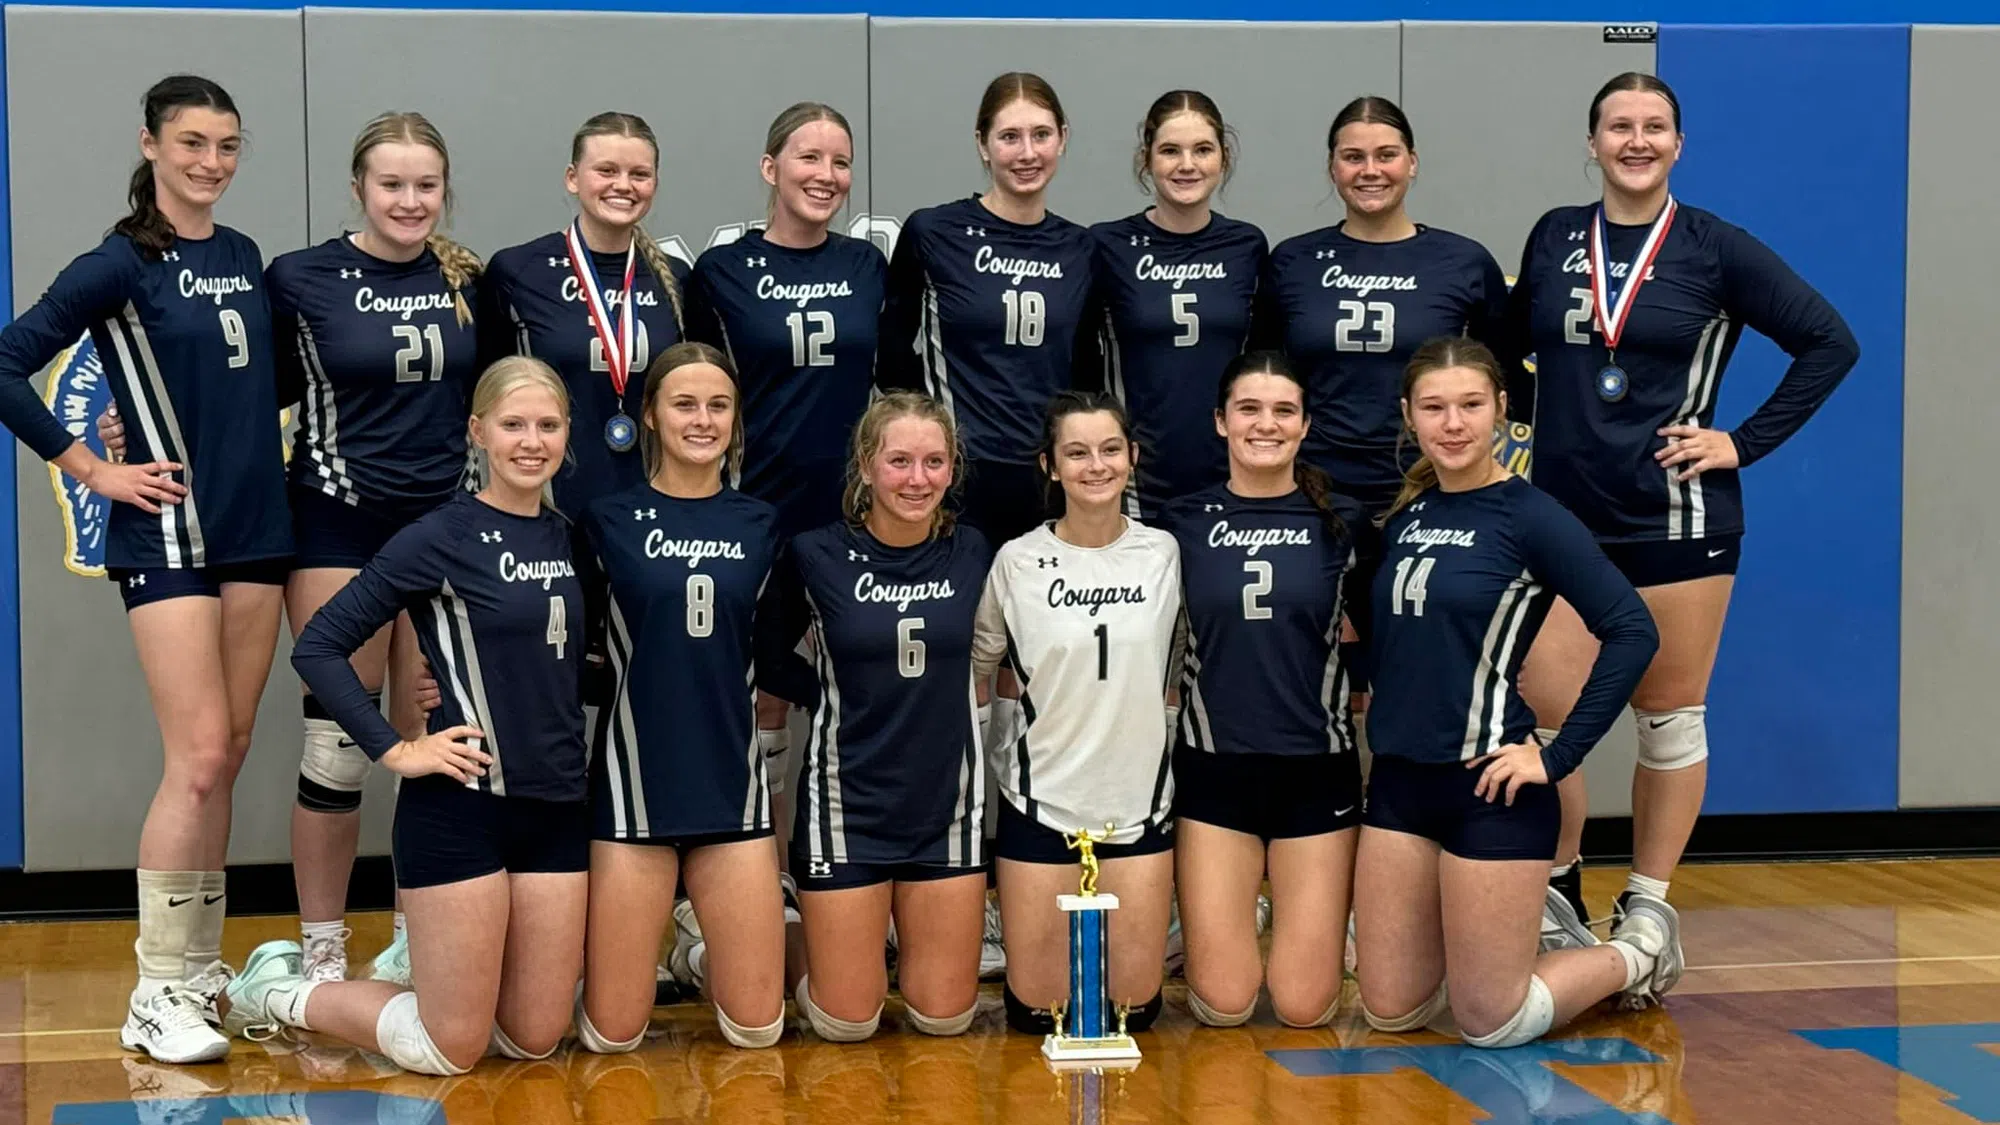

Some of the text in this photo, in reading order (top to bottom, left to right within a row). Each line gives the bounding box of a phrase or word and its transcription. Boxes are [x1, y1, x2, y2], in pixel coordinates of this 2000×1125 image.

[178, 268, 253, 306] Cougars
[974, 245, 1064, 286] Cougars
[1136, 254, 1228, 290] Cougars
[1321, 265, 1418, 298] Cougars
[355, 286, 454, 321] Cougars
[757, 274, 853, 309] Cougars
[219, 308, 249, 369] 9
[785, 310, 835, 367] 12
[1002, 289, 1046, 346] 18
[1171, 292, 1200, 347] 5
[1335, 299, 1395, 353] 23
[392, 323, 444, 383] 21
[645, 528, 746, 569] Cougars
[1208, 520, 1312, 556] Cougars
[1397, 519, 1476, 553] Cougars
[500, 551, 576, 591] Cougars
[854, 571, 955, 613] Cougars
[1242, 560, 1273, 620] 2
[1392, 556, 1437, 617] 14
[686, 574, 714, 638] 8
[1047, 578, 1147, 617] Cougars
[546, 595, 567, 660] 4
[897, 617, 926, 678] 6
[1093, 623, 1108, 681] 1
